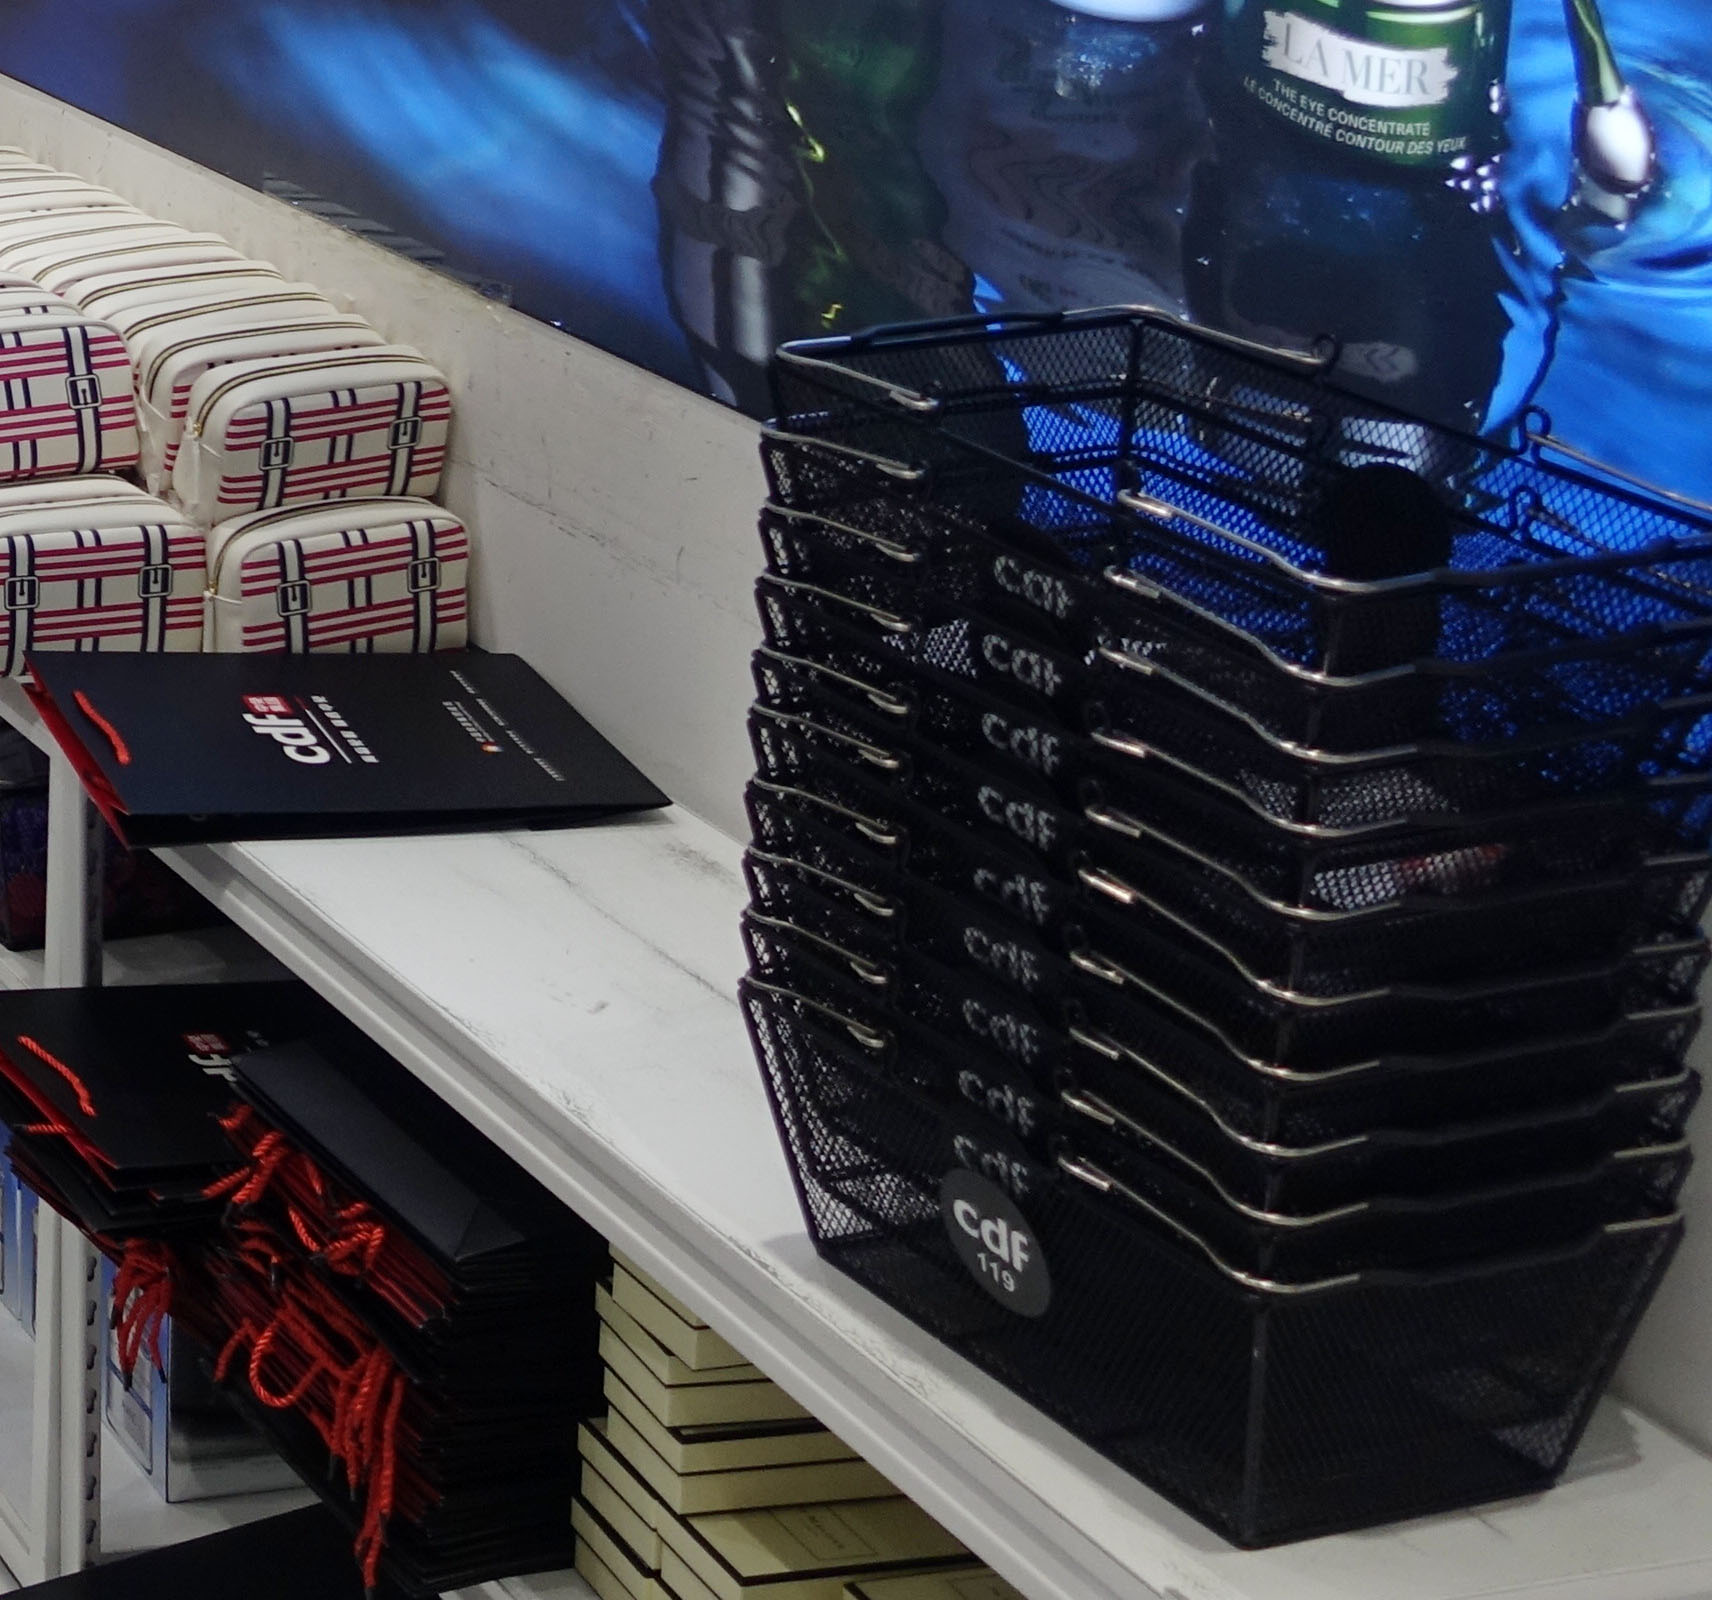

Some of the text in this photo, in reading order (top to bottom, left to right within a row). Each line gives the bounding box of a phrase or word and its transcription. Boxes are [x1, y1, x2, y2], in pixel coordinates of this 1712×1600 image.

[1283, 22, 1433, 96] LA MER
[1258, 85, 1334, 139] CONCENTRÉ
[1335, 128, 1405, 155] CONTOUR
[1406, 138, 1434, 156] DES
[1273, 78, 1431, 138] THE EYE CONCENTRATE
[242, 712, 331, 764] cdf
[952, 1199, 1031, 1273] cdf
[977, 1251, 1016, 1293] 119
